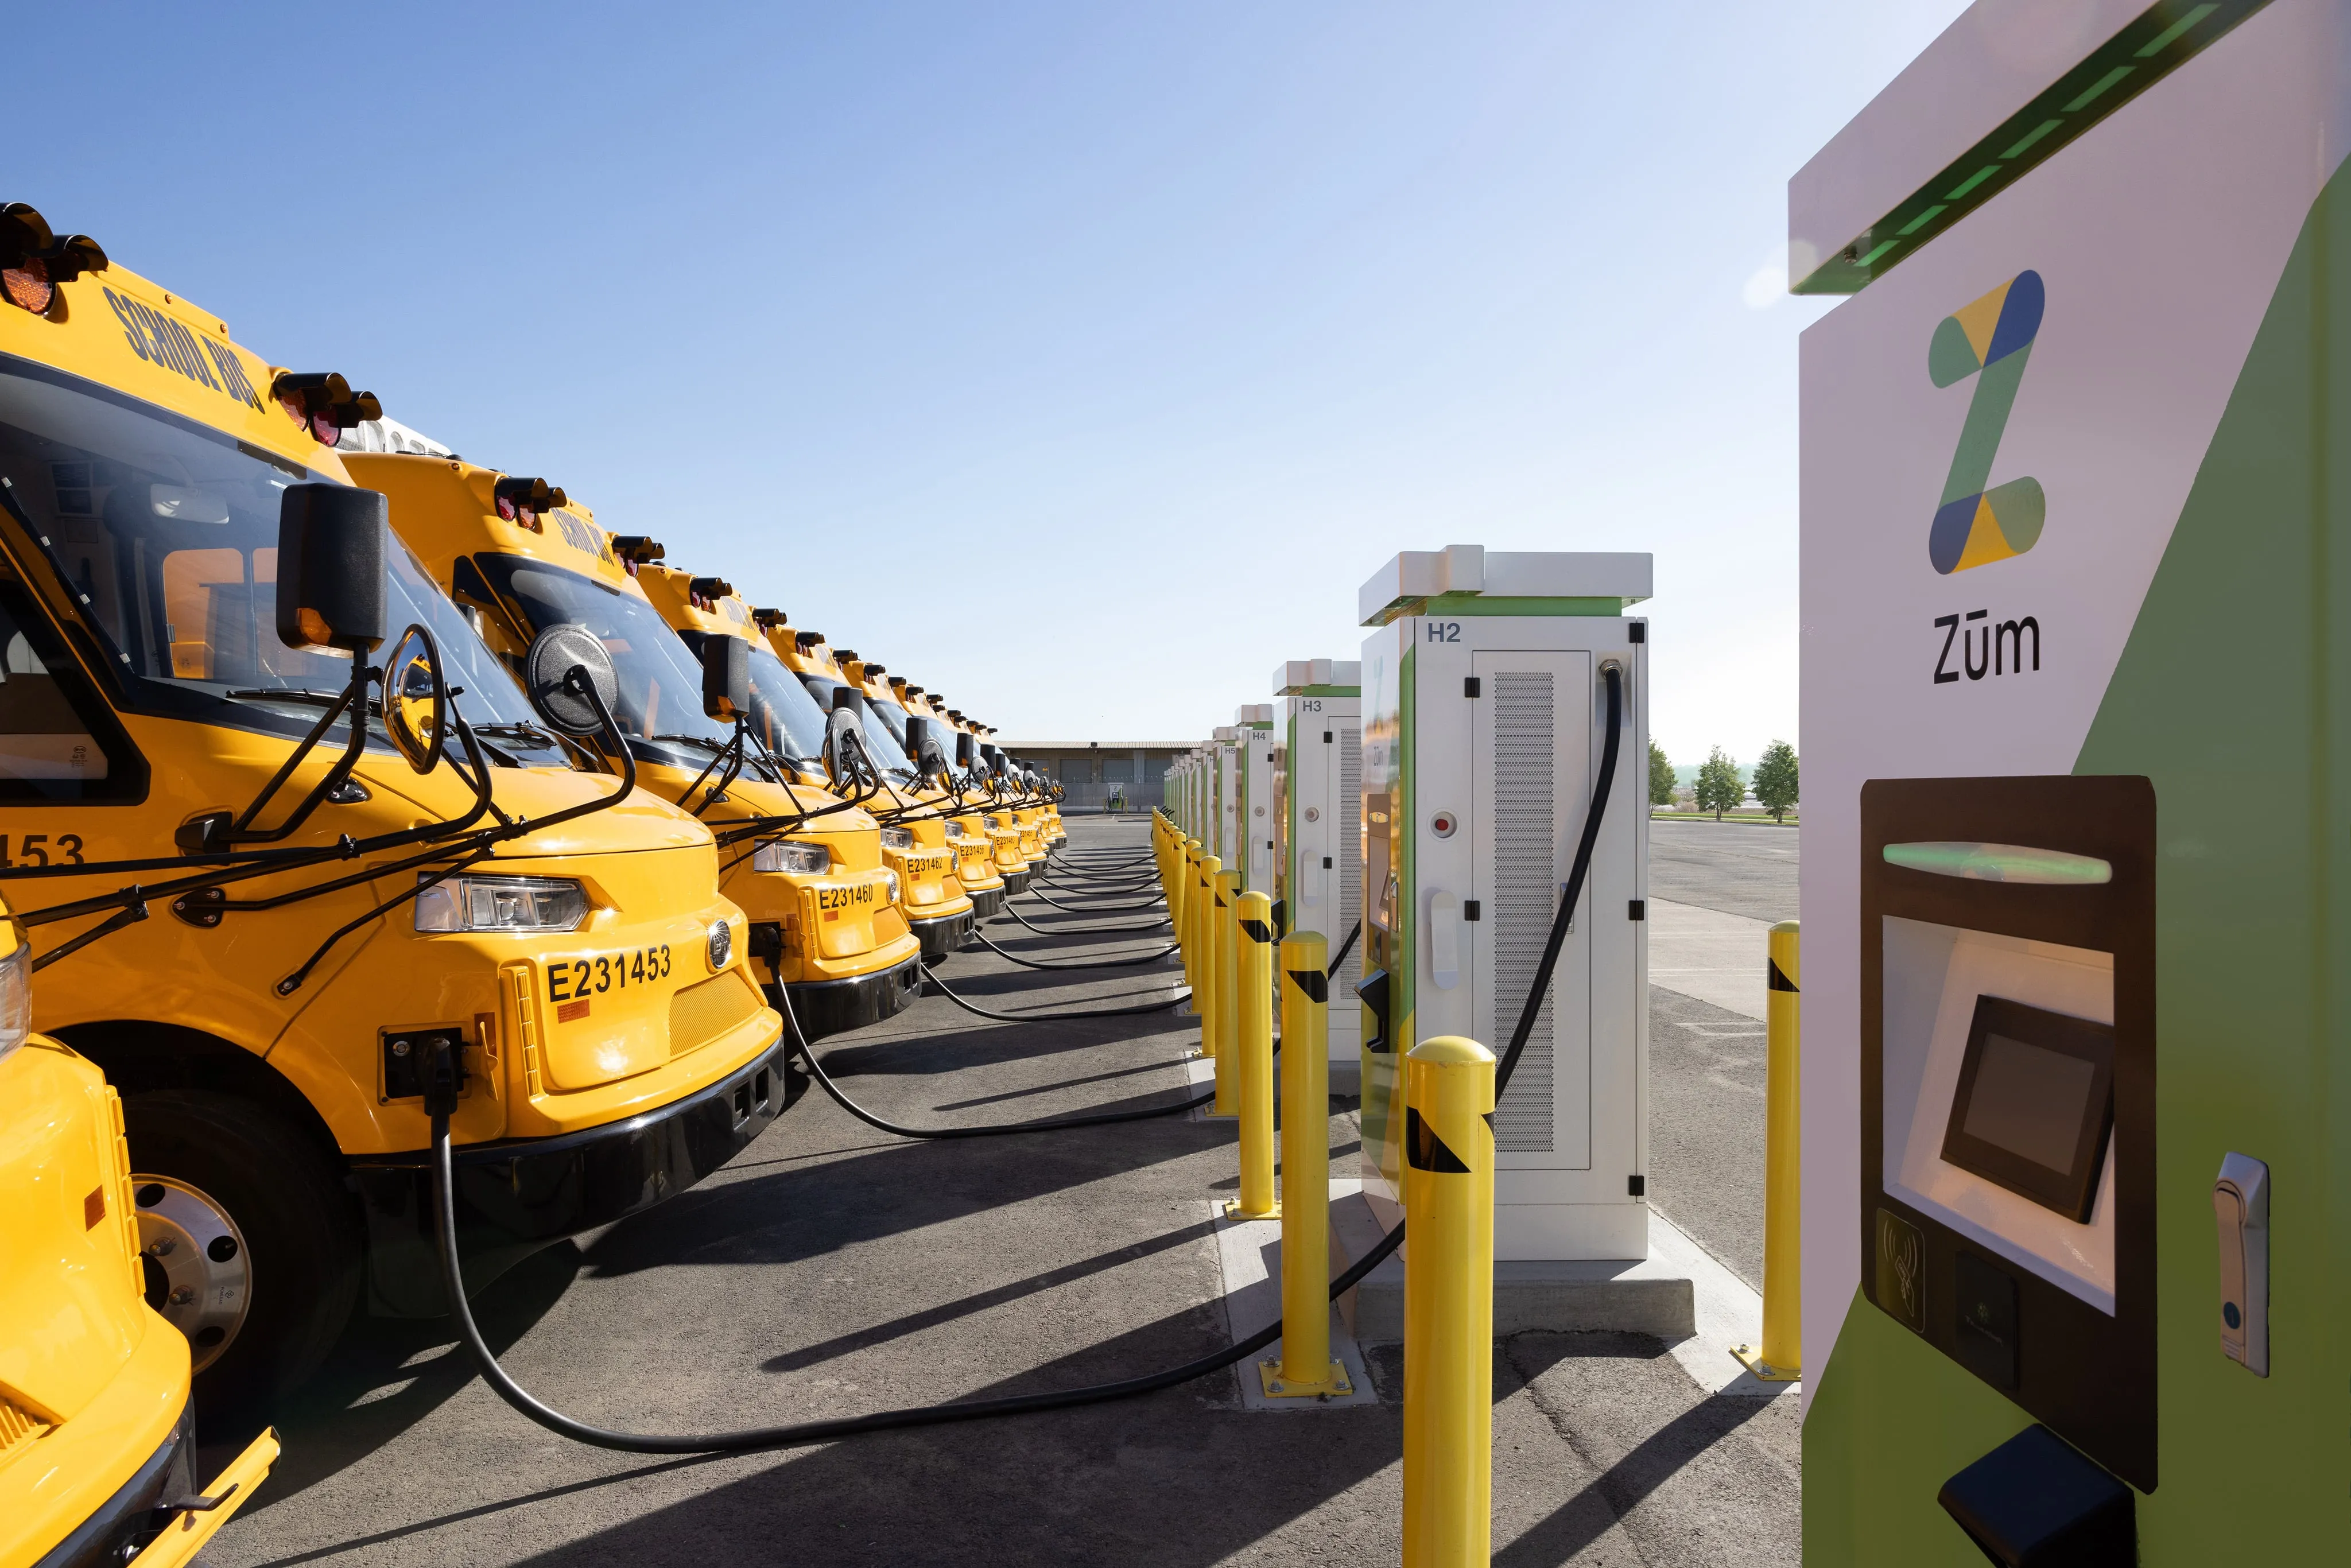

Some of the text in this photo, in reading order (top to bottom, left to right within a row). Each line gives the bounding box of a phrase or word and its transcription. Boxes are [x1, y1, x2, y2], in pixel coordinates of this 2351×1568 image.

[102, 286, 265, 414] SCHOOL BUS
[1428, 623, 1461, 643] H2
[1933, 608, 2040, 685] Zūm
[1302, 700, 1322, 712] H3
[1252, 732, 1266, 740] H4
[907, 856, 942, 873] E231462
[819, 883, 873, 909] E231460
[547, 944, 671, 1002] E231453
